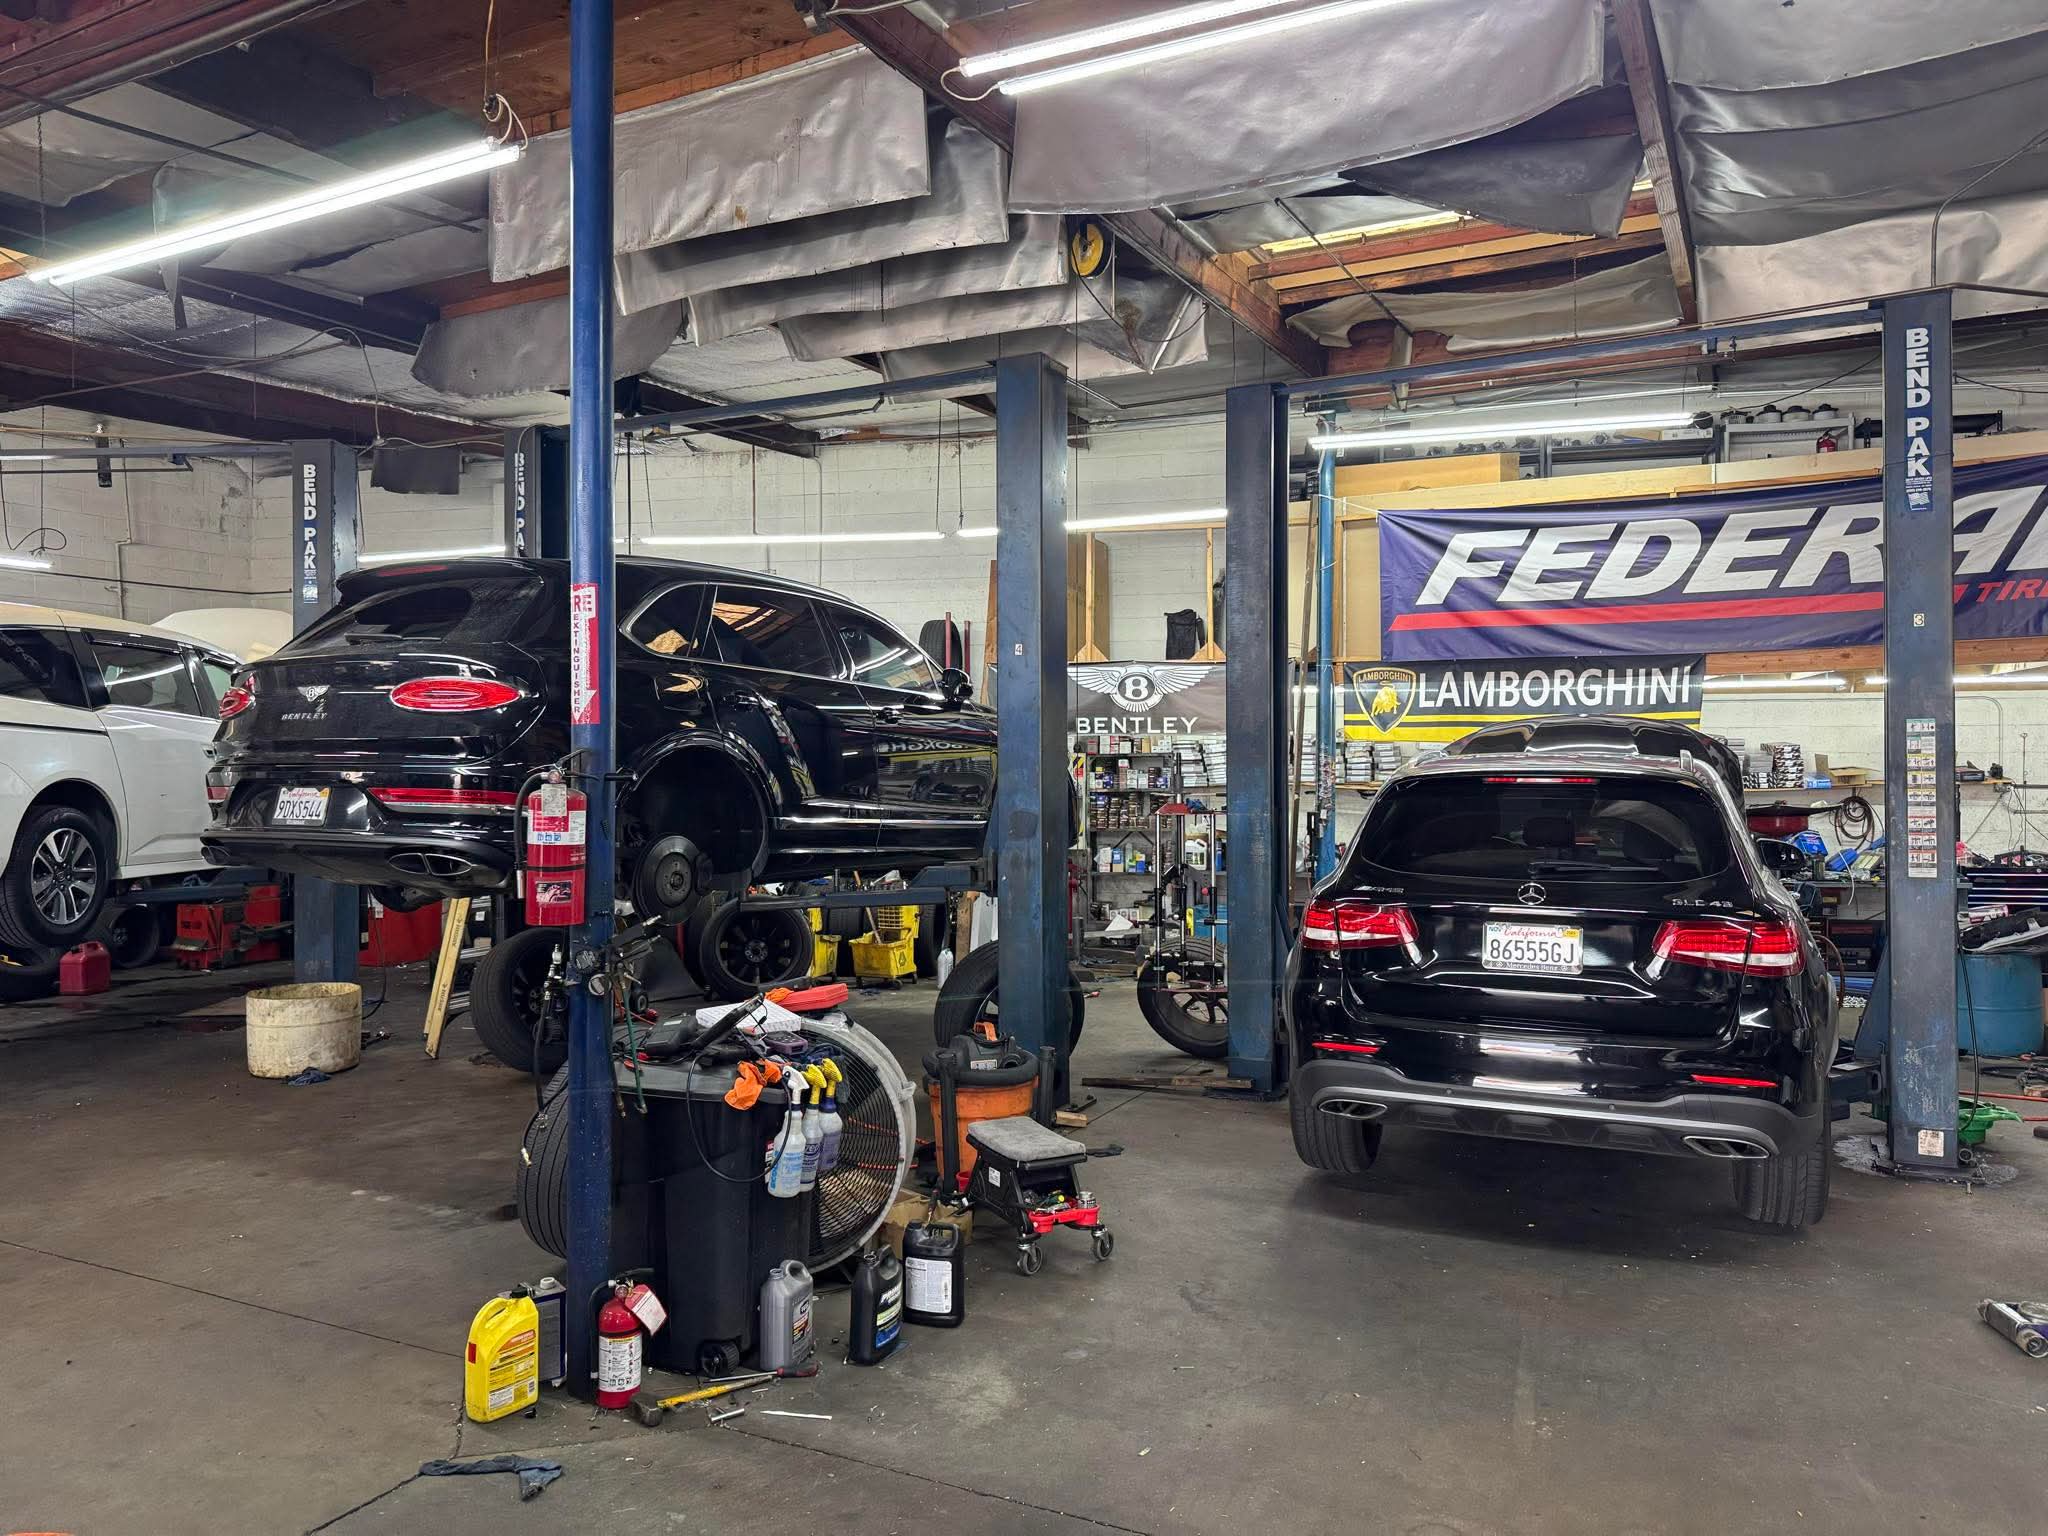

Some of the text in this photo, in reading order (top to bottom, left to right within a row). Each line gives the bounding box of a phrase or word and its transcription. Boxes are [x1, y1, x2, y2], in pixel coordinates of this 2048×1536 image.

[1906, 327, 1931, 408] BEND
[1906, 418, 1931, 477] PAK
[303, 464, 317, 520] BEND
[515, 518, 525, 550] PA
[303, 527, 317, 569] PAK
[1914, 614, 1924, 626] 3
[1124, 676, 1149, 700] B
[1357, 669, 1412, 683] LAMBORGHINI
[1418, 667, 1691, 708] LAMBORGHINI
[281, 712, 328, 721] BENTLEY
[1077, 717, 1199, 734] BENTLEY
[276, 800, 322, 818] 9DXS544
[1504, 926, 1563, 939] California
[1490, 939, 1574, 964] 86555GJ
